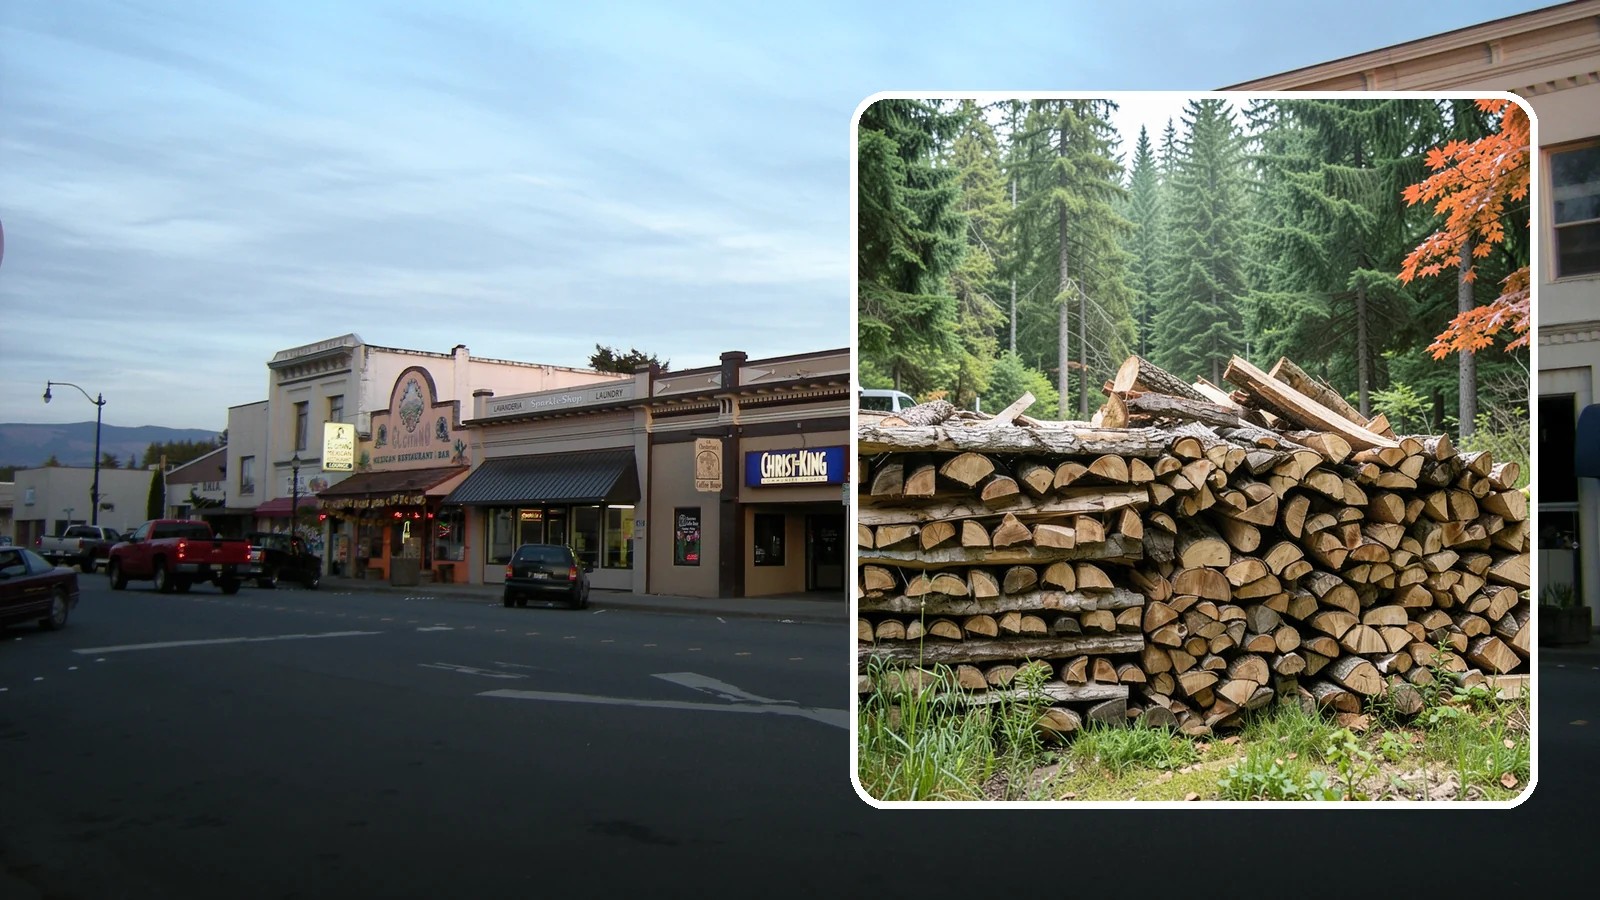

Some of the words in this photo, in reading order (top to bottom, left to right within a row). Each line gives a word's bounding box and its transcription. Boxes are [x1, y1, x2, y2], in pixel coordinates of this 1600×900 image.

[493, 402, 523, 412] LAVANDERIA
[562, 394, 583, 405] Shop
[595, 389, 624, 400] LAUNDRY
[373, 454, 396, 464] MEXICAN
[397, 451, 434, 462] RESTAURANT
[437, 450, 450, 459] BAR
[760, 452, 797, 478] CHRIST
[799, 450, 827, 477] KING
[696, 481, 709, 489] Coffee
